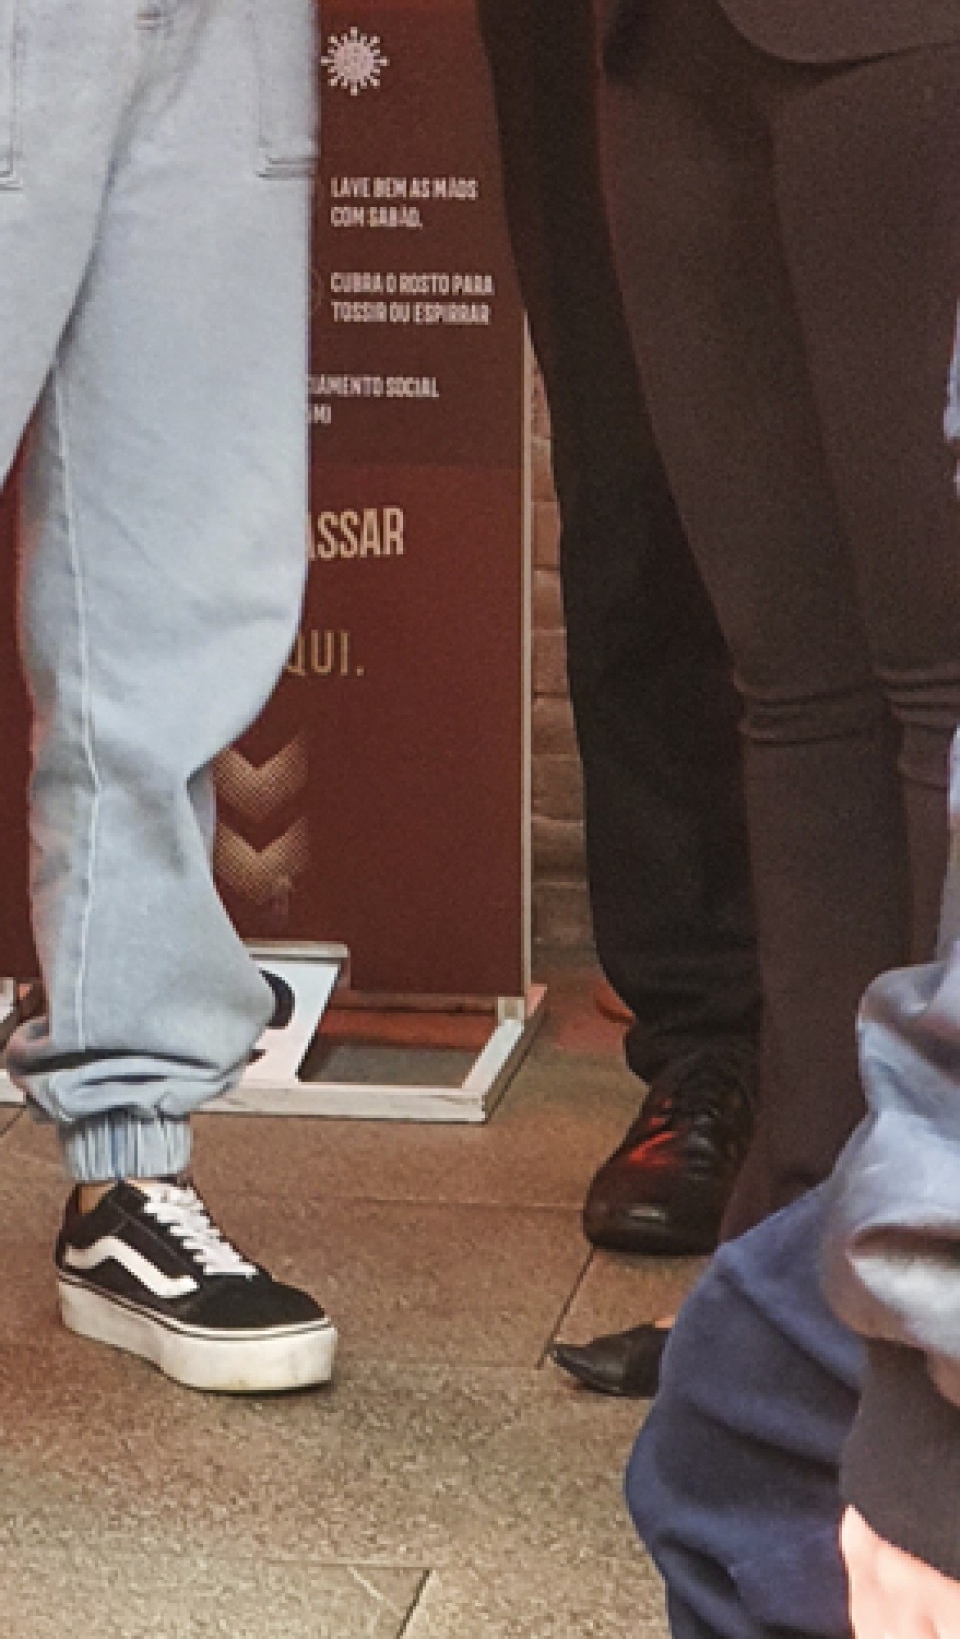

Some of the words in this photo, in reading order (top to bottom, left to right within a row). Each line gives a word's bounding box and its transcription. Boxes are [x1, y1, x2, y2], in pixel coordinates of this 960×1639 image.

[331, 176, 371, 198] LAVE
[373, 176, 407, 198] BEM
[409, 176, 430, 198] AS
[432, 175, 479, 200] MÃOS
[330, 206, 365, 228] COM
[330, 271, 383, 294] CUBRA
[386, 272, 397, 294] O
[399, 272, 450, 295] ROSTO
[452, 273, 495, 295] PARA
[331, 301, 387, 322] TOSSIR
[389, 302, 411, 323] OU
[413, 302, 491, 325] ESPIRRAR
[386, 376, 440, 398] SOCIAL
